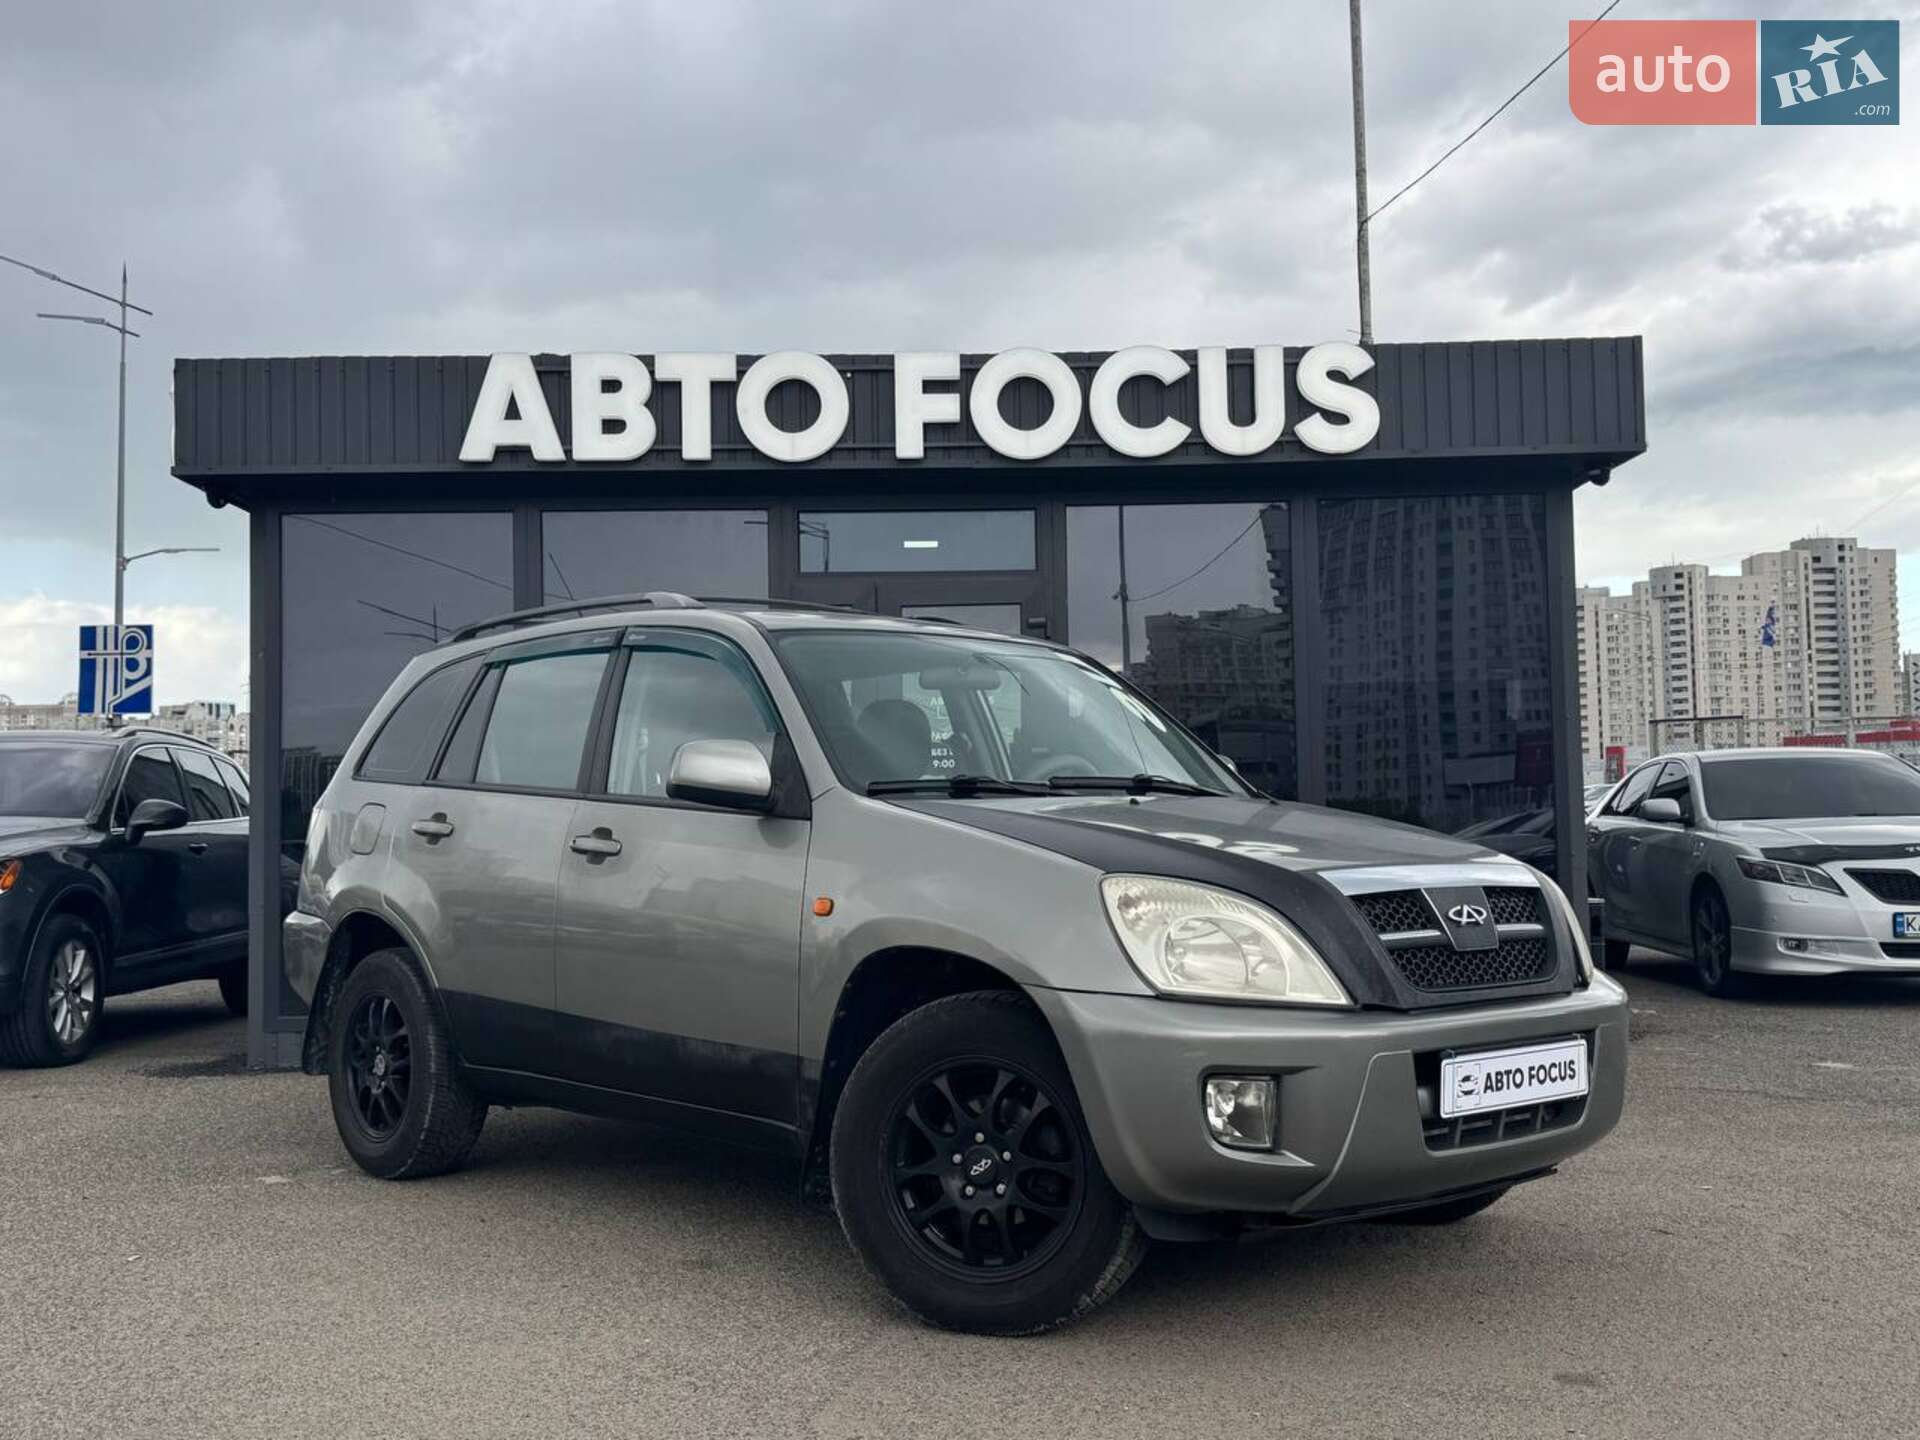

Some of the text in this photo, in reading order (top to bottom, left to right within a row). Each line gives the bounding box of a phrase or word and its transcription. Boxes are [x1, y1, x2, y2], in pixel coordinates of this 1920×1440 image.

[458, 341, 1380, 463] АВТО FOCUS
[1483, 1059, 1576, 1094] АВТО FOCUS
